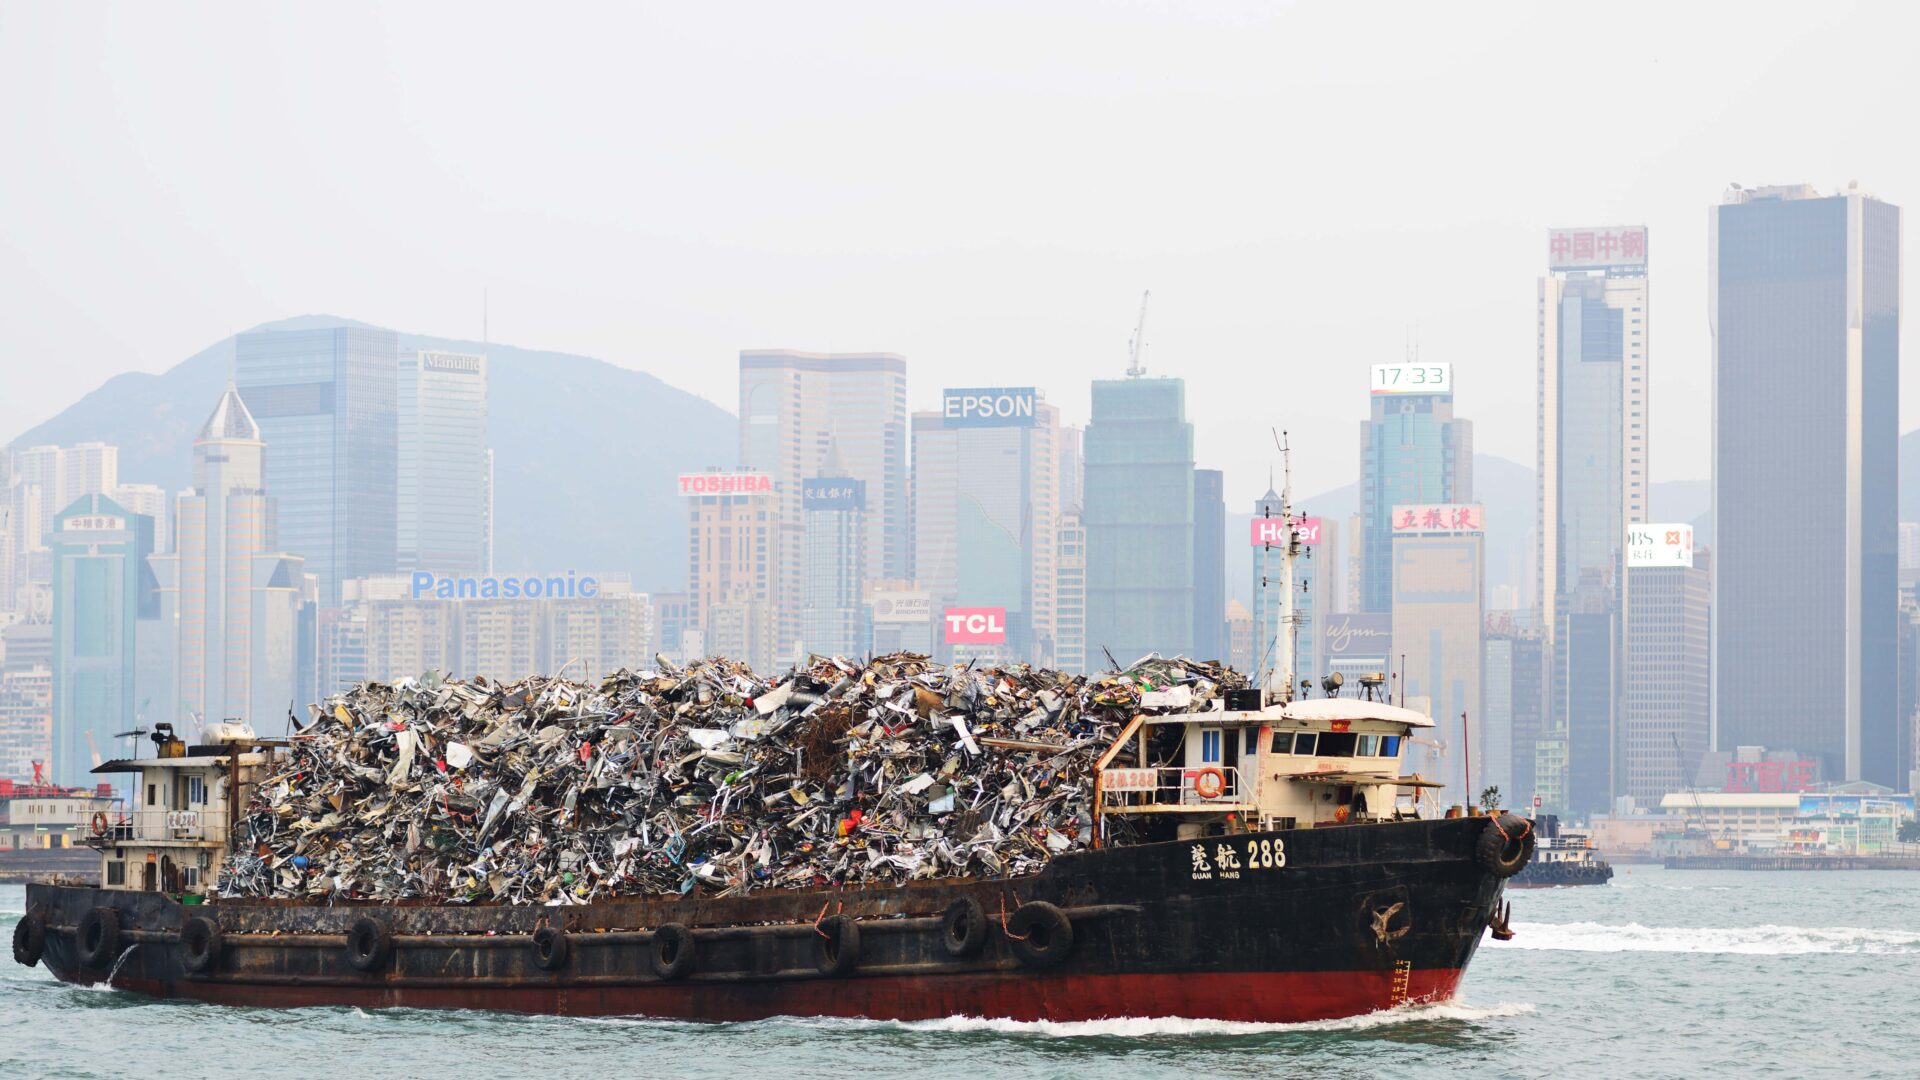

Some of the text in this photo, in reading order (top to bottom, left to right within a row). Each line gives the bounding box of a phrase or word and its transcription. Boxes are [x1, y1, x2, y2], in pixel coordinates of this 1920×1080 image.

[424, 353, 481, 371] Manulife
[1379, 368, 1443, 384] 17:33
[945, 395, 1032, 417] EPSON
[679, 475, 771, 493] TOSHIBA
[1394, 507, 1478, 529] 五粮液
[412, 569, 598, 598] Panasonic
[946, 614, 1004, 633] TCL
[1247, 838, 1286, 869] 288
[1191, 871, 1240, 880] GUAN HANG
